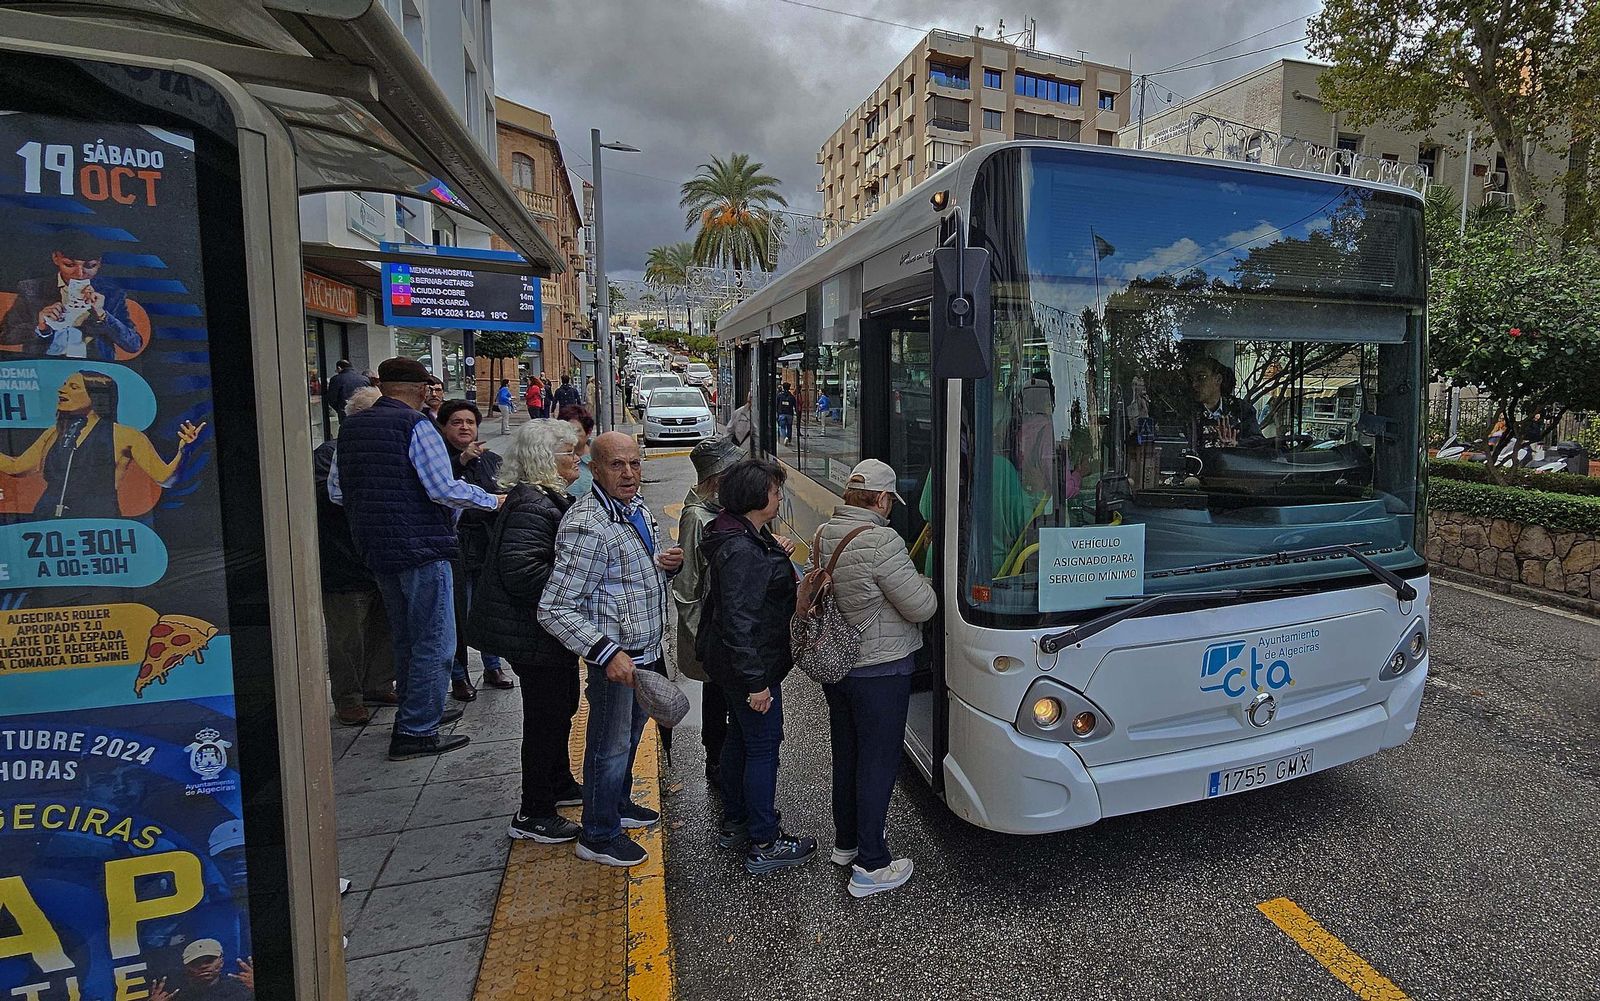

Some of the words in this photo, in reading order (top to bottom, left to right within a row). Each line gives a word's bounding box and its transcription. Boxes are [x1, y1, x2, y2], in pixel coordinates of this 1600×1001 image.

[83, 139, 164, 169] SÁBADO
[17, 141, 74, 195] 19
[80, 164, 161, 207] OCT
[398, 275, 403, 283] 2
[409, 266, 474, 278] MENACHA-HOSPITAL
[304, 276, 353, 314] ATCHALOT
[410, 286, 466, 297] N.CIUDAD-COBRE
[519, 293, 534, 301] 14m
[400, 296, 404, 304] 3
[519, 302, 534, 311] 23m
[421, 307, 464, 318] 28-10-2024
[465, 309, 485, 319] 12:04
[0, 367, 38, 379] DEMIA
[22, 529, 136, 559] 20:30H
[1072, 536, 1121, 550] VEHÍCULO
[37, 561, 50, 578] A
[57, 557, 128, 577] 00:30H
[1054, 556, 1108, 567] ASIGNADO
[1111, 553, 1134, 564] PARA
[1049, 573, 1096, 584] SERVICIO
[1098, 568, 1137, 581] MÍNIMO
[7, 611, 69, 625] ALGECIRAS
[72, 609, 111, 621] ROLLER
[17, 621, 80, 636] APROPADIS
[83, 620, 102, 631] 2.0
[10, 635, 41, 647] ARTE
[44, 634, 60, 645] DE
[63, 633, 77, 644] LA
[80, 630, 124, 642] ESPADA
[1258, 629, 1320, 648] Ayuntamiento
[45, 645, 61, 656] DE
[64, 640, 128, 655] RECREARTE
[1264, 650, 1276, 660] de
[1279, 643, 1320, 659] Algeciras
[10, 655, 67, 670] COMARCA
[70, 654, 90, 665] DEL
[94, 651, 129, 663] SWING
[90, 735, 156, 765] 2024
[1223, 765, 1267, 792] 1755
[1276, 753, 1310, 780] GMX
[185, 779, 235, 790] Ayuntamiento
[197, 785, 236, 794] Algeciras
